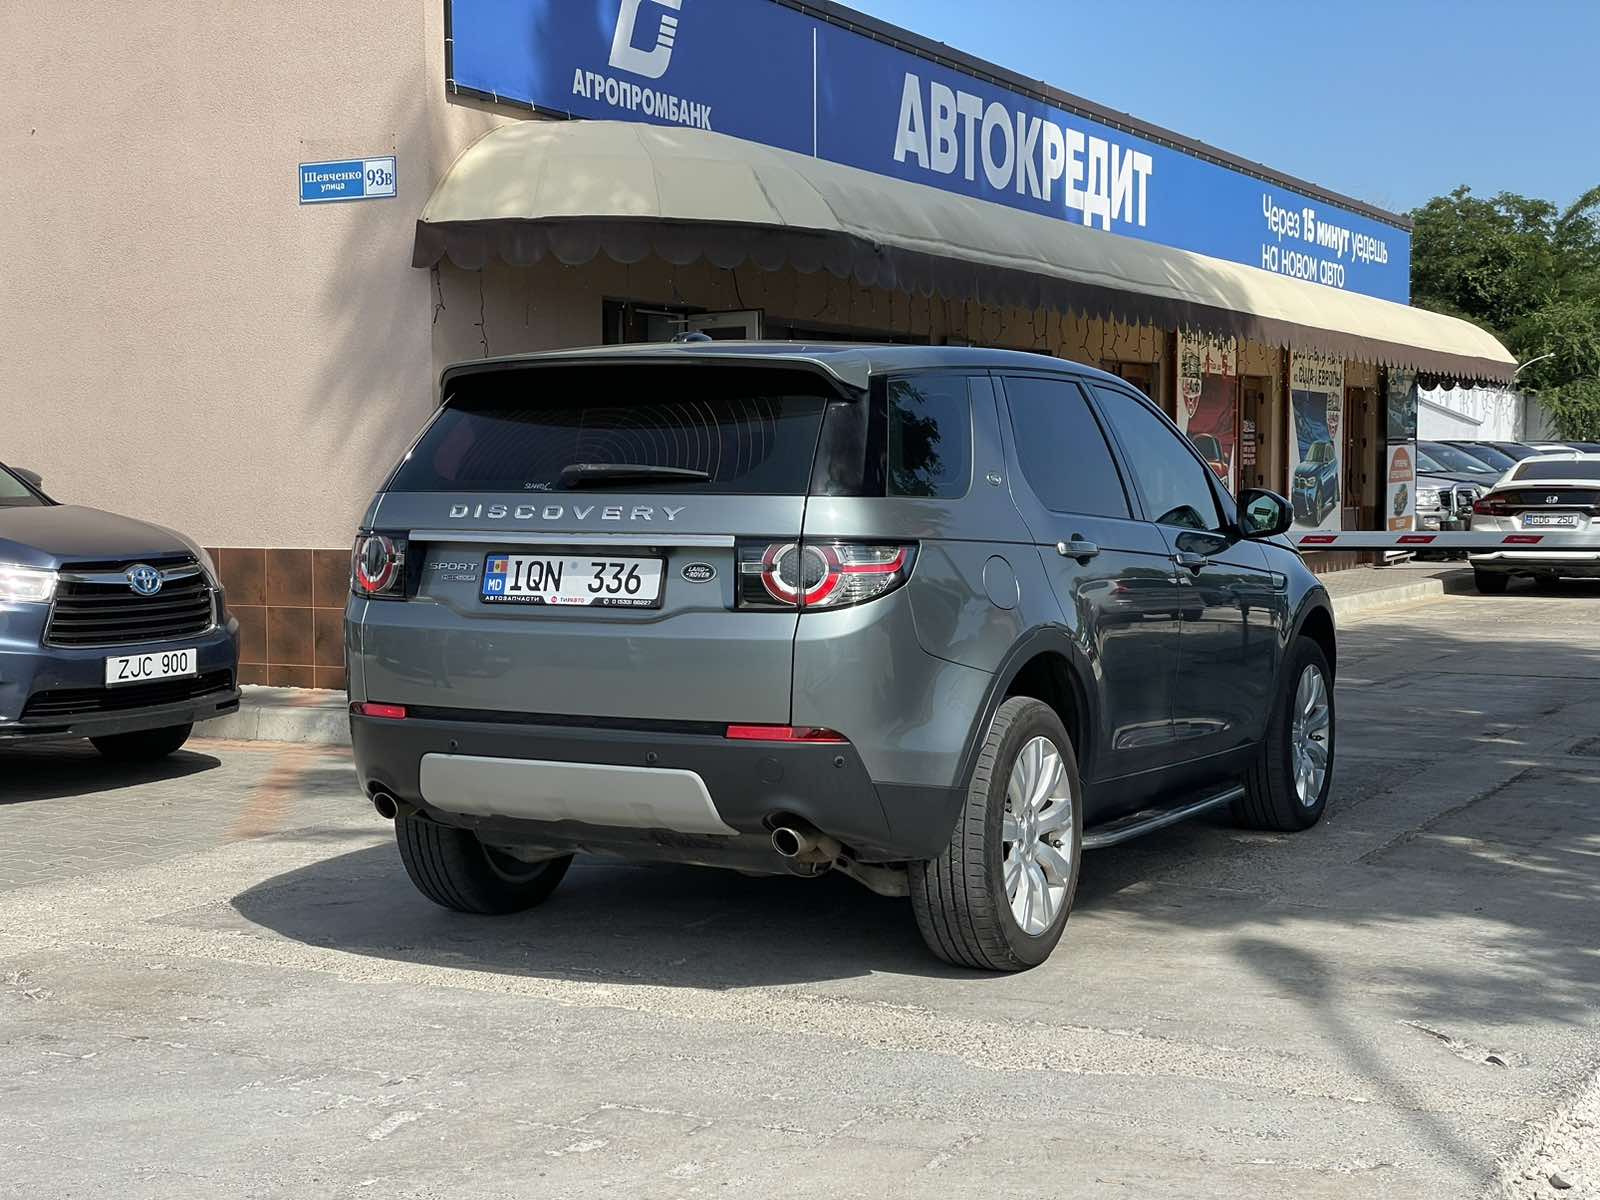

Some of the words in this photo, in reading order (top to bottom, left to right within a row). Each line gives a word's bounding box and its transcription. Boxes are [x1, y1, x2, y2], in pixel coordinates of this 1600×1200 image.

[572, 68, 712, 130] АГРОПРОМБАНК
[893, 72, 1153, 232] АВТОКРЕДИТ
[303, 171, 362, 183] Шевченко
[320, 182, 345, 192] улица
[1262, 193, 1300, 242] Через
[1302, 207, 1315, 243] 15
[1316, 220, 1350, 259] минут
[1350, 231, 1388, 265] уедешь
[1261, 243, 1279, 272] на
[1281, 248, 1317, 282] новом
[1319, 259, 1345, 288] авто
[449, 503, 687, 521] DISCOVERY
[430, 562, 478, 571] SPORT
[509, 560, 564, 592] IQN
[587, 561, 642, 595] 336
[487, 578, 503, 591] MD
[118, 656, 153, 679] ZJC
[161, 652, 188, 674] 900
